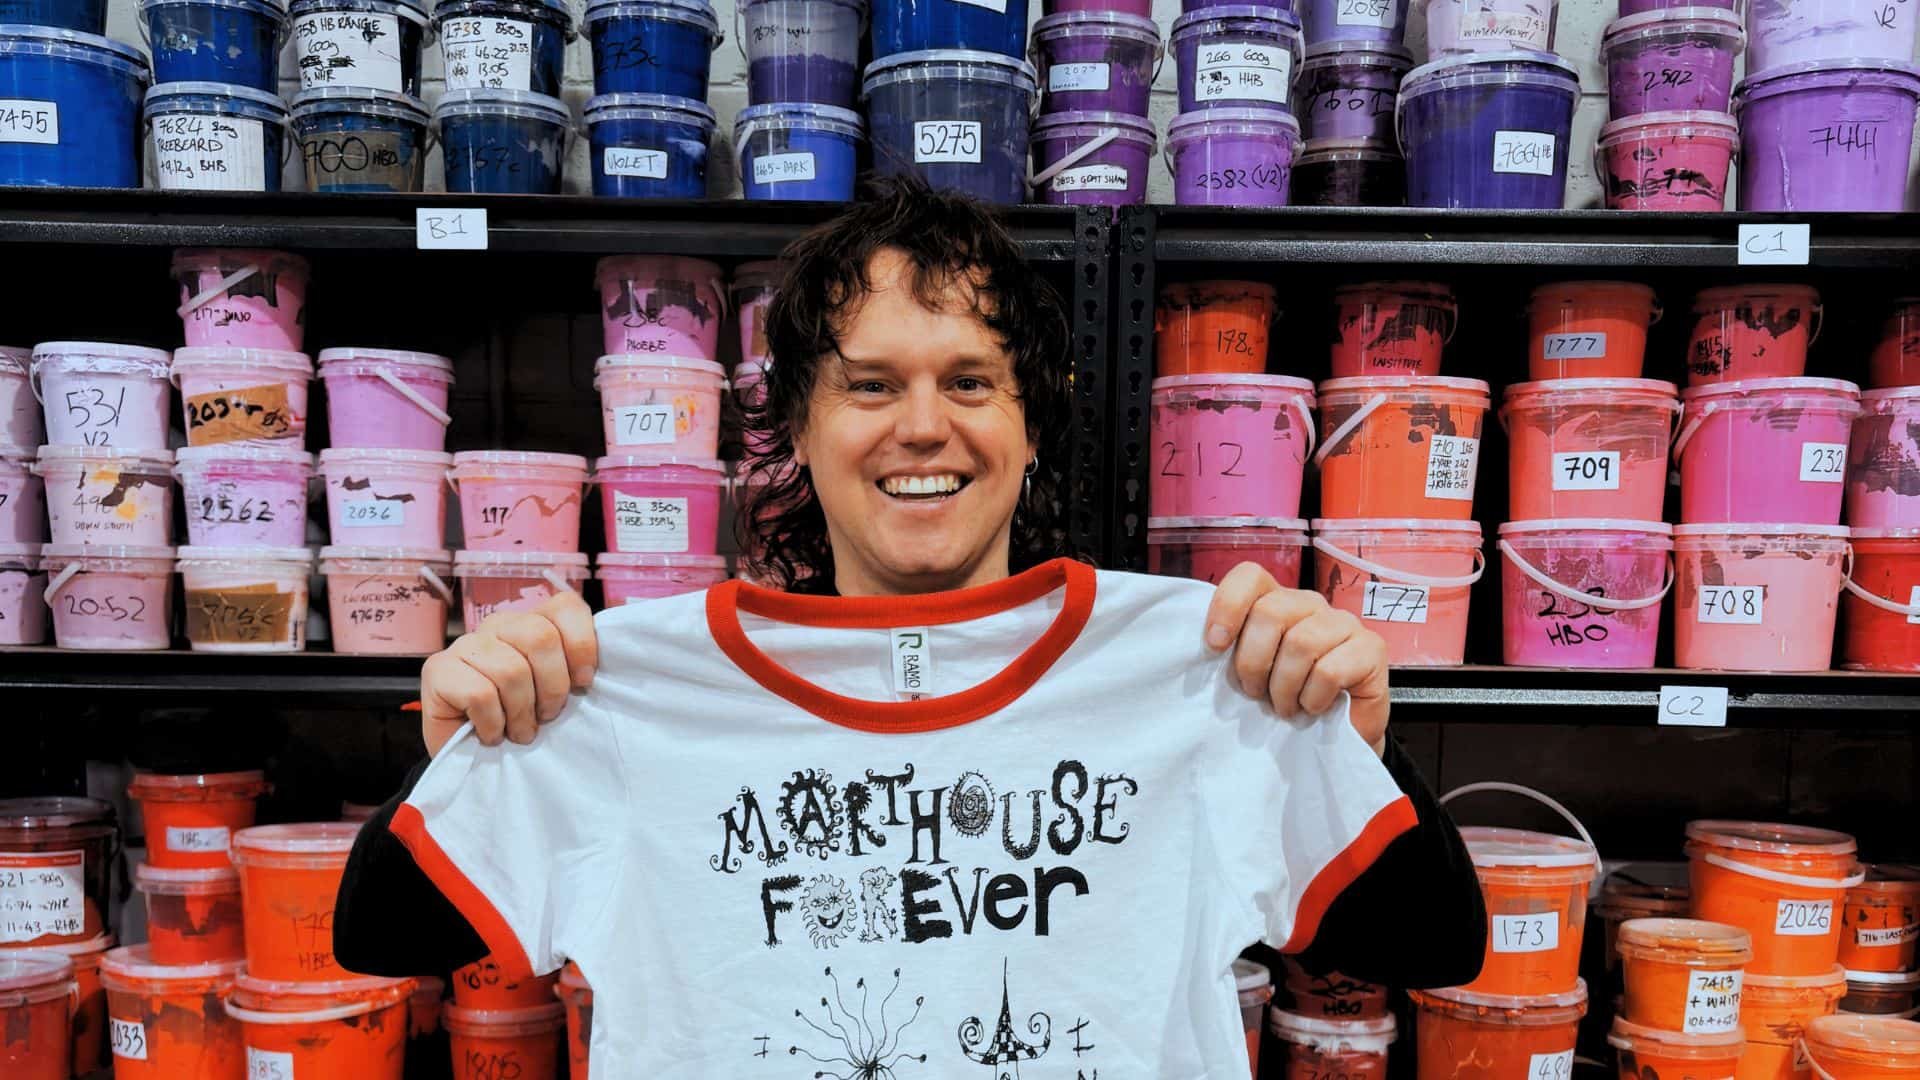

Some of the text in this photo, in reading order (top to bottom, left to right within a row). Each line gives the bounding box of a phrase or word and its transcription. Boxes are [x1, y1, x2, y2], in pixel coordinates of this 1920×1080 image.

[1243, 50, 1270, 66] 600g
[1644, 71, 1693, 91] 2592
[159, 117, 203, 136] 7684
[919, 125, 977, 156] 5275
[1809, 127, 1877, 161] 7441
[606, 153, 658, 171] VIOLET
[1502, 142, 1541, 170] 7664
[1197, 169, 1247, 190] 2582
[1547, 337, 1597, 355] 1777
[627, 411, 669, 435] 707
[1161, 440, 1247, 478] 212
[1565, 456, 1611, 482] 709
[1810, 448, 1844, 474] 232
[348, 506, 391, 526] 2036
[1364, 585, 1427, 622] 177
[1703, 589, 1755, 616] 708
[1546, 621, 1609, 647] HBO
[907, 654, 921, 689] RAMO
[1666, 695, 1705, 717] C2
[710, 760, 1139, 874] MARTHOUSE
[1780, 903, 1830, 929] 2026
[1502, 918, 1545, 947] 173
